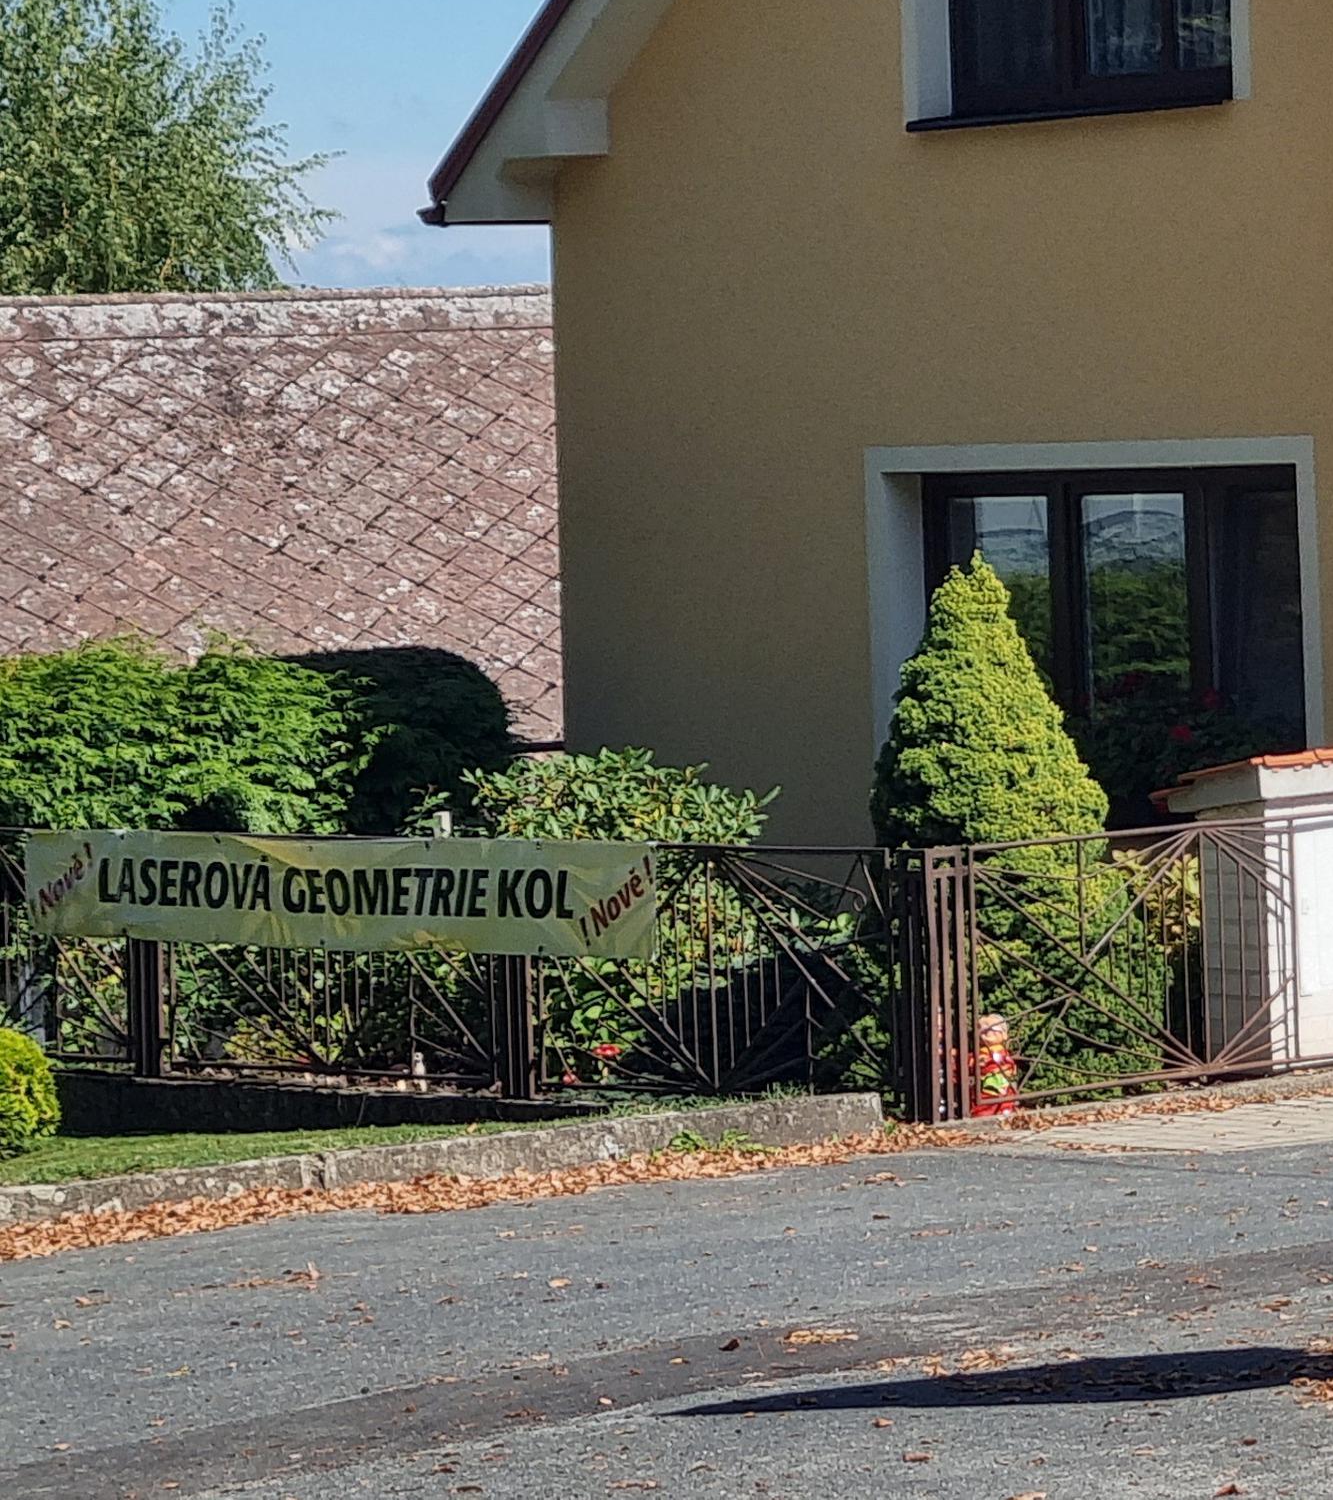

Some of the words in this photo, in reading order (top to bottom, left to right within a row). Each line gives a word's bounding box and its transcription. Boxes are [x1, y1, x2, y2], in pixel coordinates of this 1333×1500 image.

[99, 855, 272, 911] LASEROVÁ
[282, 867, 489, 918] GEOMETRIE
[497, 868, 574, 920] KOL
